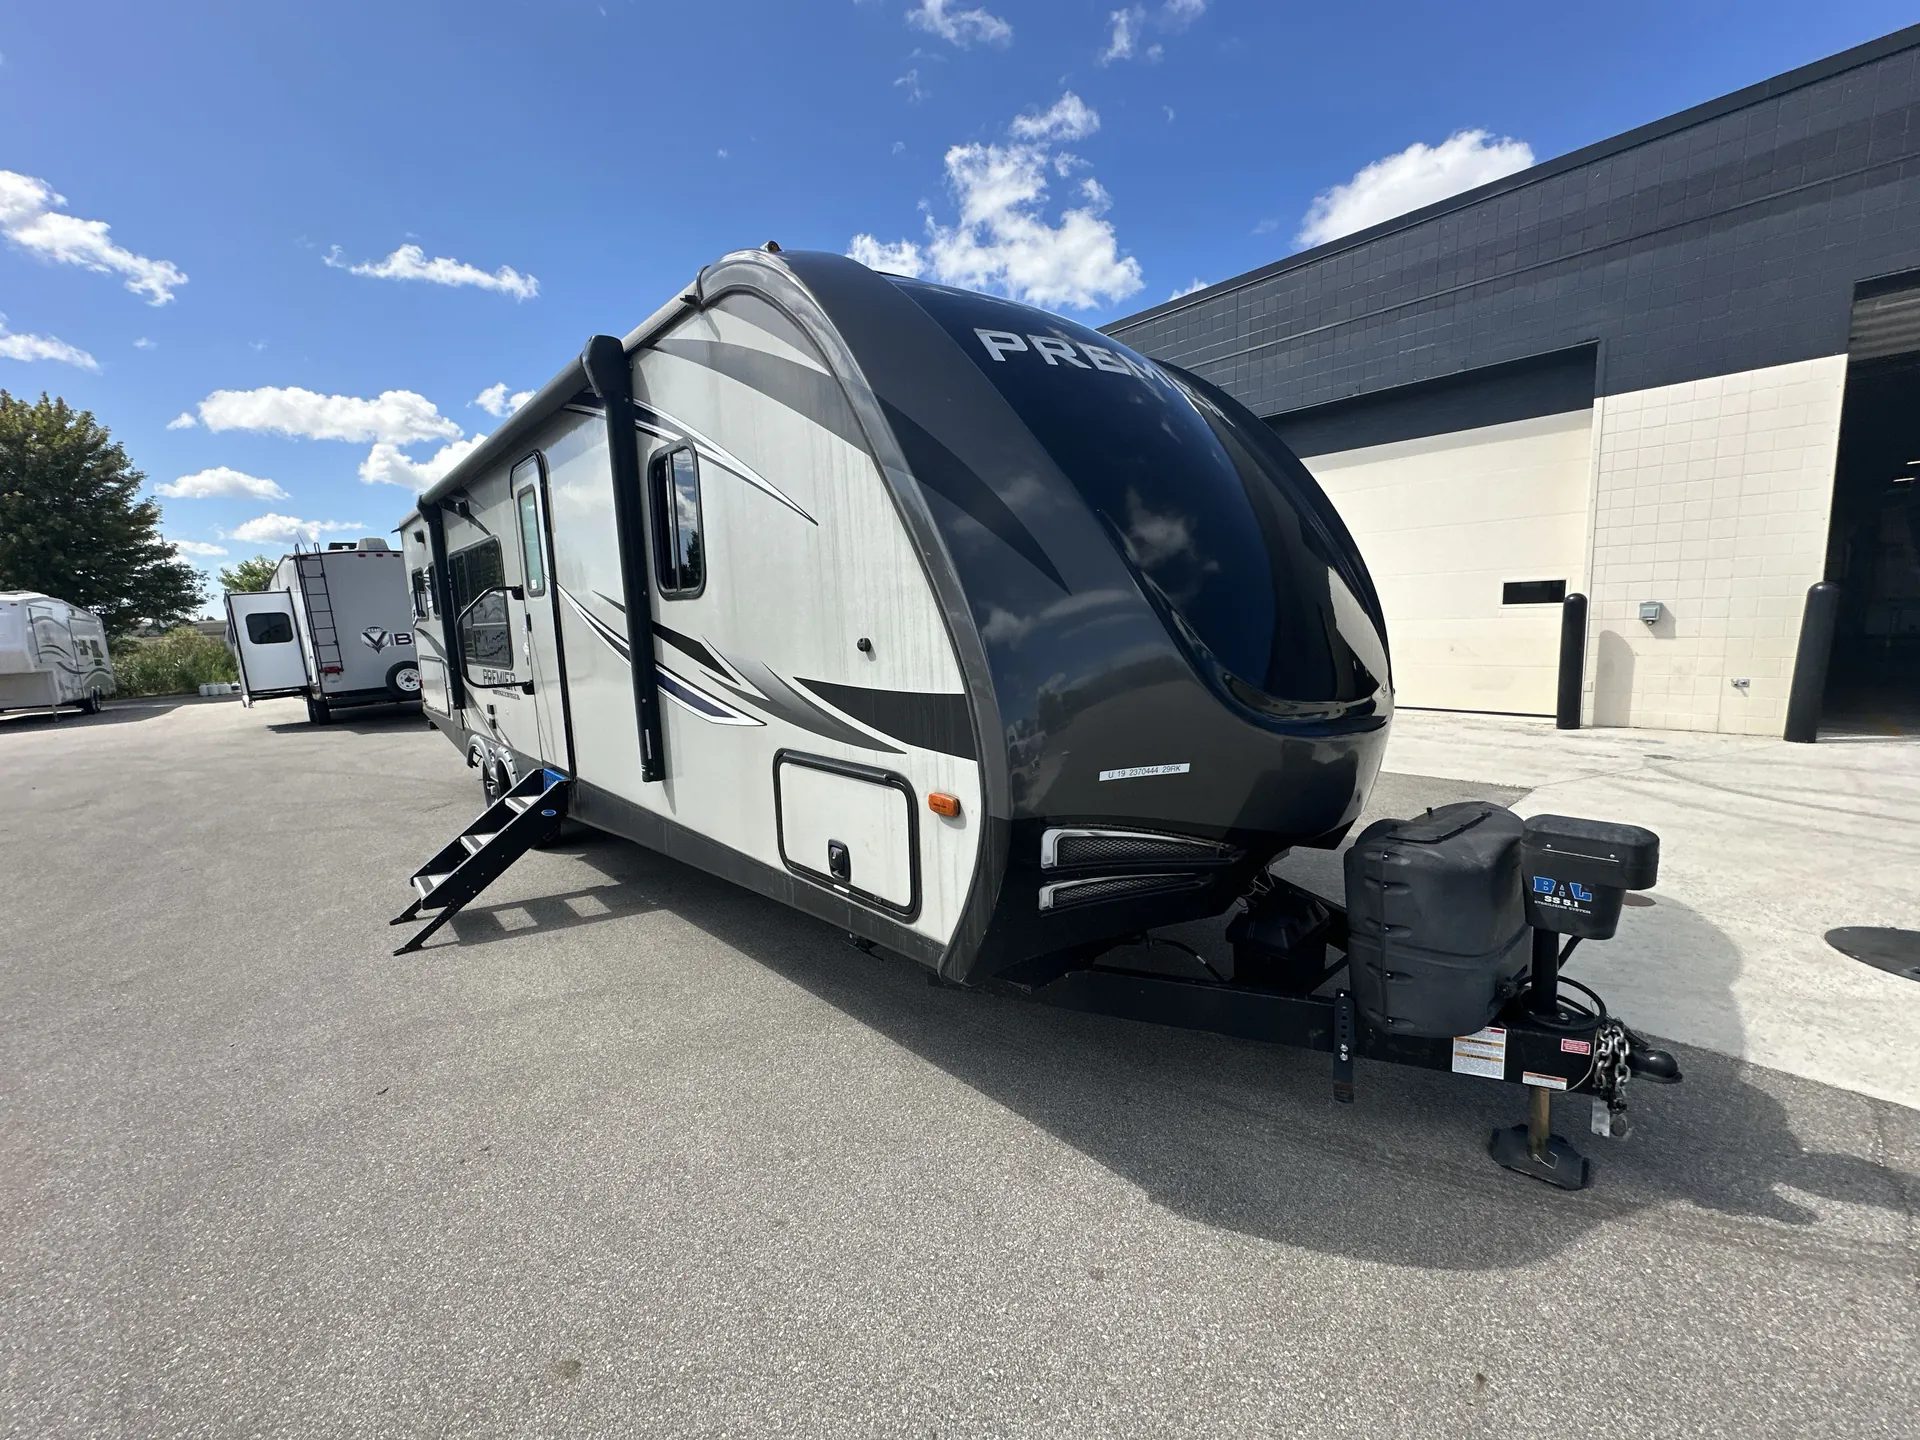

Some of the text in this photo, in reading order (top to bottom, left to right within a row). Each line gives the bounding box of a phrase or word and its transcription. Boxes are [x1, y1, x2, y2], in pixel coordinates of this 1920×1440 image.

[362, 631, 416, 654] VIB
[1129, 767, 1159, 776] 2370444
[1162, 765, 1181, 773] 29RK
[1544, 895, 1560, 904] SS
